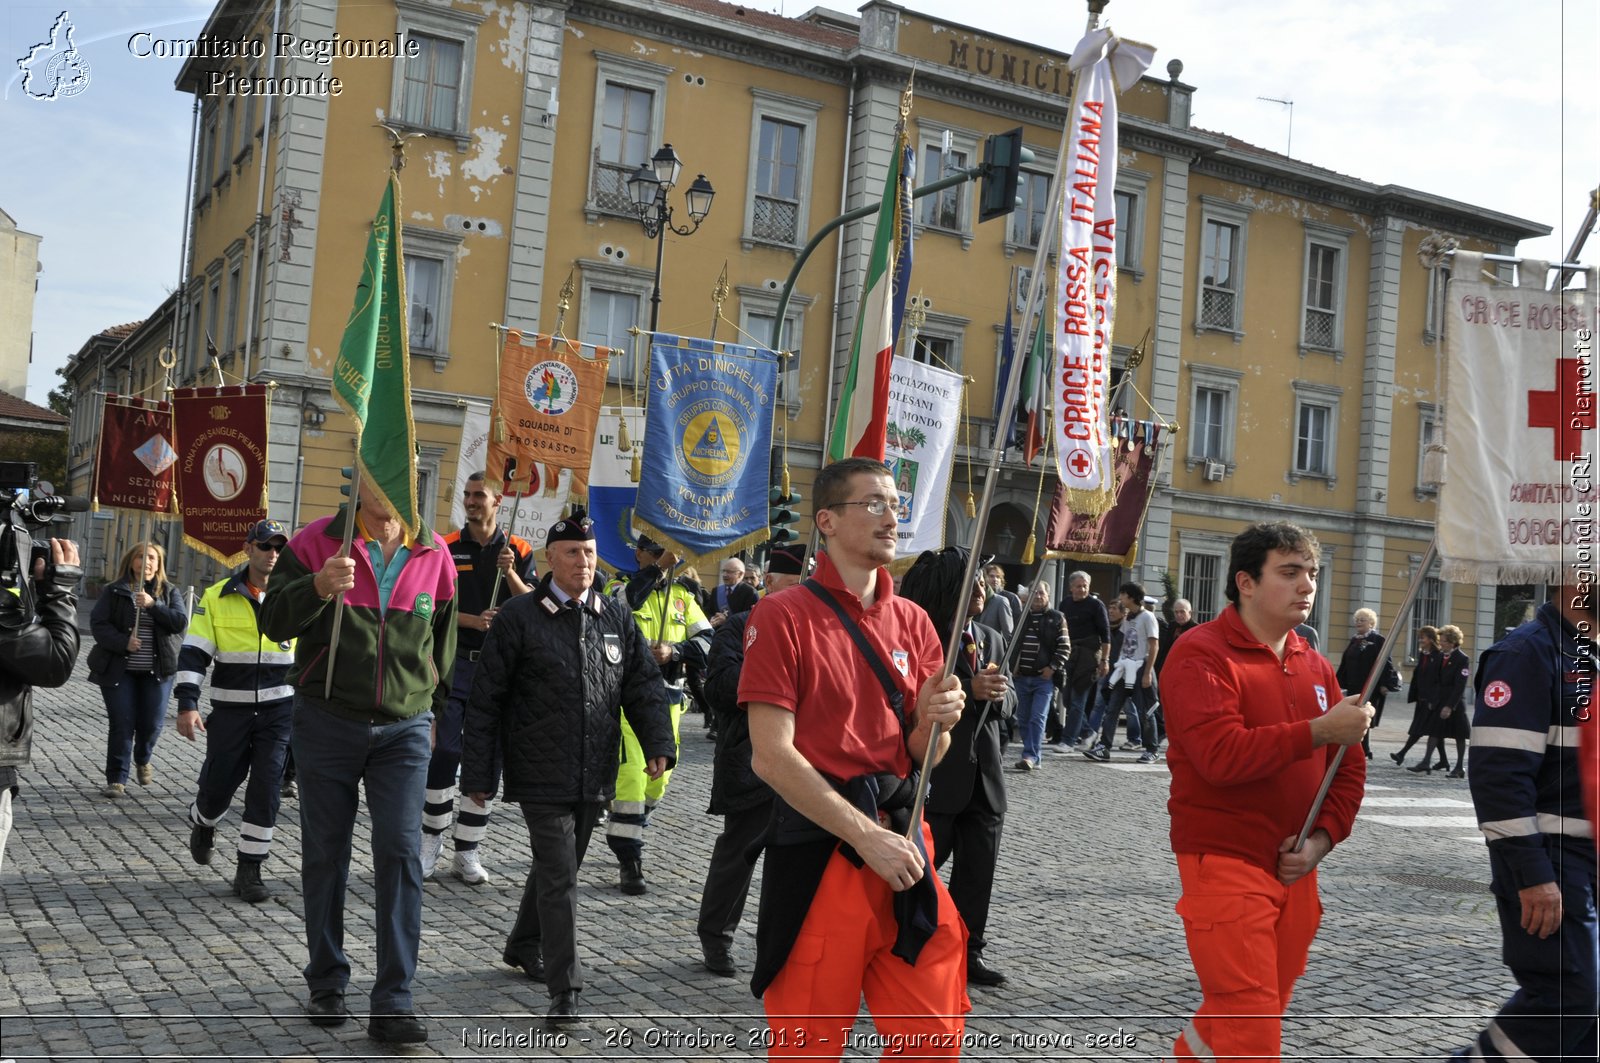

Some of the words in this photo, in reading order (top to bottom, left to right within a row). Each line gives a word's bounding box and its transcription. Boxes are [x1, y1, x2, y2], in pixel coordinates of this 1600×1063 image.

[1070, 101, 1104, 226] ITALIANA
[1064, 247, 1090, 337] ROSSA
[1461, 294, 1522, 328] CROCE
[698, 358, 712, 371] DI
[715, 359, 768, 405] NICHELINO
[667, 380, 709, 409] GRUPPO
[711, 380, 757, 421] COMUNALE
[1063, 355, 1092, 441] CROCE
[679, 401, 710, 426] GRUPPO
[902, 410, 942, 430] MONDO
[518, 418, 560, 434] SQUADRA
[564, 426, 573, 436] DI
[184, 432, 208, 474] DONATORI
[207, 426, 238, 439] SANGUE
[509, 434, 577, 455] FROSSASCO
[678, 485, 736, 508] VOLONTARI
[1509, 482, 1574, 504] COMITATO
[185, 507, 217, 517] GRUPPO
[217, 507, 260, 517] COMUNALE
[531, 511, 543, 522] DI
[656, 497, 721, 531] PROTEZIONE
[722, 506, 751, 529] CIVILE
[203, 521, 256, 533] NICHELINO
